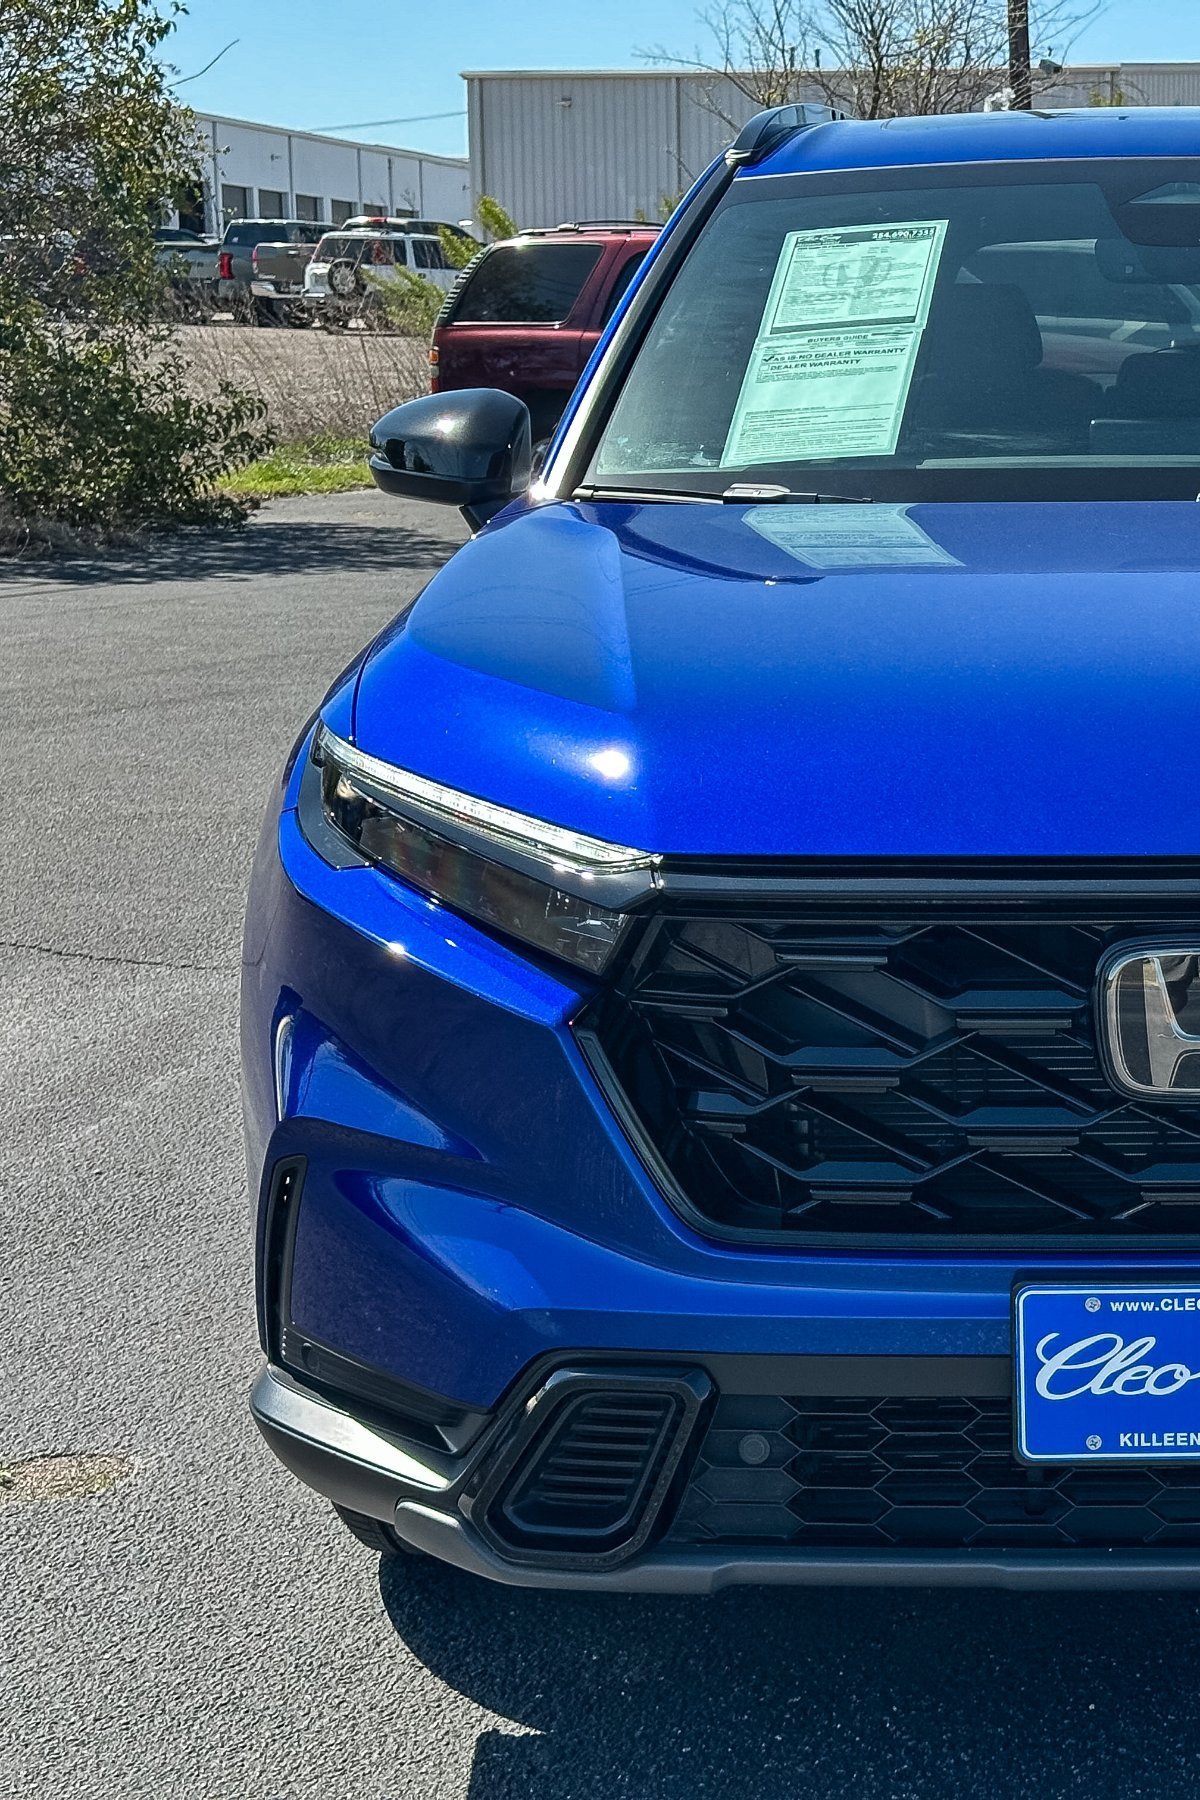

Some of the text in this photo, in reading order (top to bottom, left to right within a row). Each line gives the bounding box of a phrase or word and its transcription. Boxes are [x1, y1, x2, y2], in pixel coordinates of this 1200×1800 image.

[807, 335, 841, 344] BUYERS
[814, 350, 851, 359] DEALER
[853, 347, 906, 356] WARRANTY
[770, 358, 861, 371] DEALER WARRANTY
